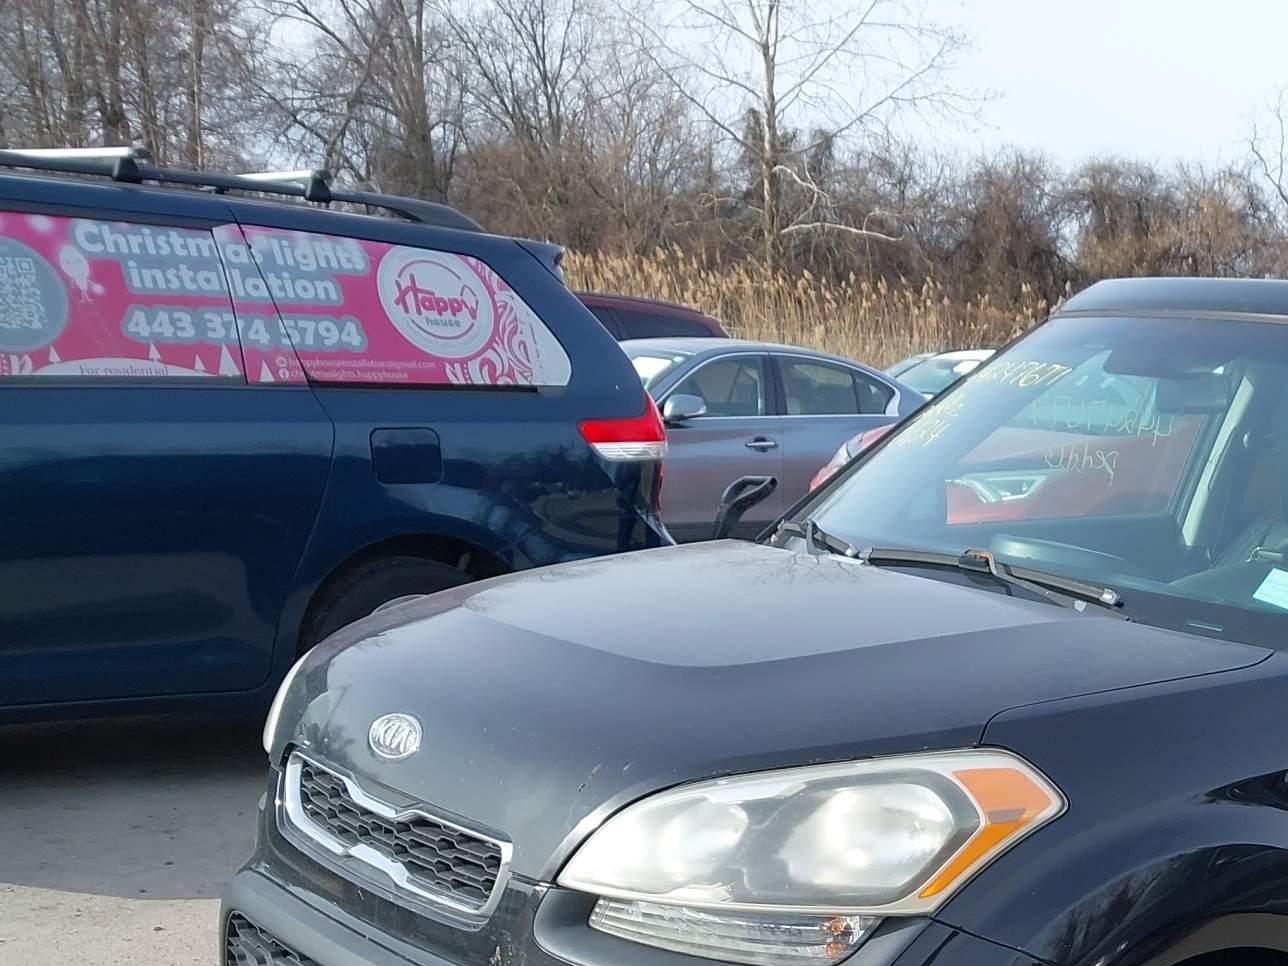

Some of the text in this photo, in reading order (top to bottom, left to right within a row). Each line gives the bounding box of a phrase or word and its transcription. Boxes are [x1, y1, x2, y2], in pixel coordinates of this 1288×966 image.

[73, 222, 367, 272] Christmas lights
[127, 261, 340, 301] installation
[394, 273, 480, 321] Happy
[127, 310, 363, 347] 443 374 5794
[425, 315, 462, 328] house
[79, 365, 100, 376] For
